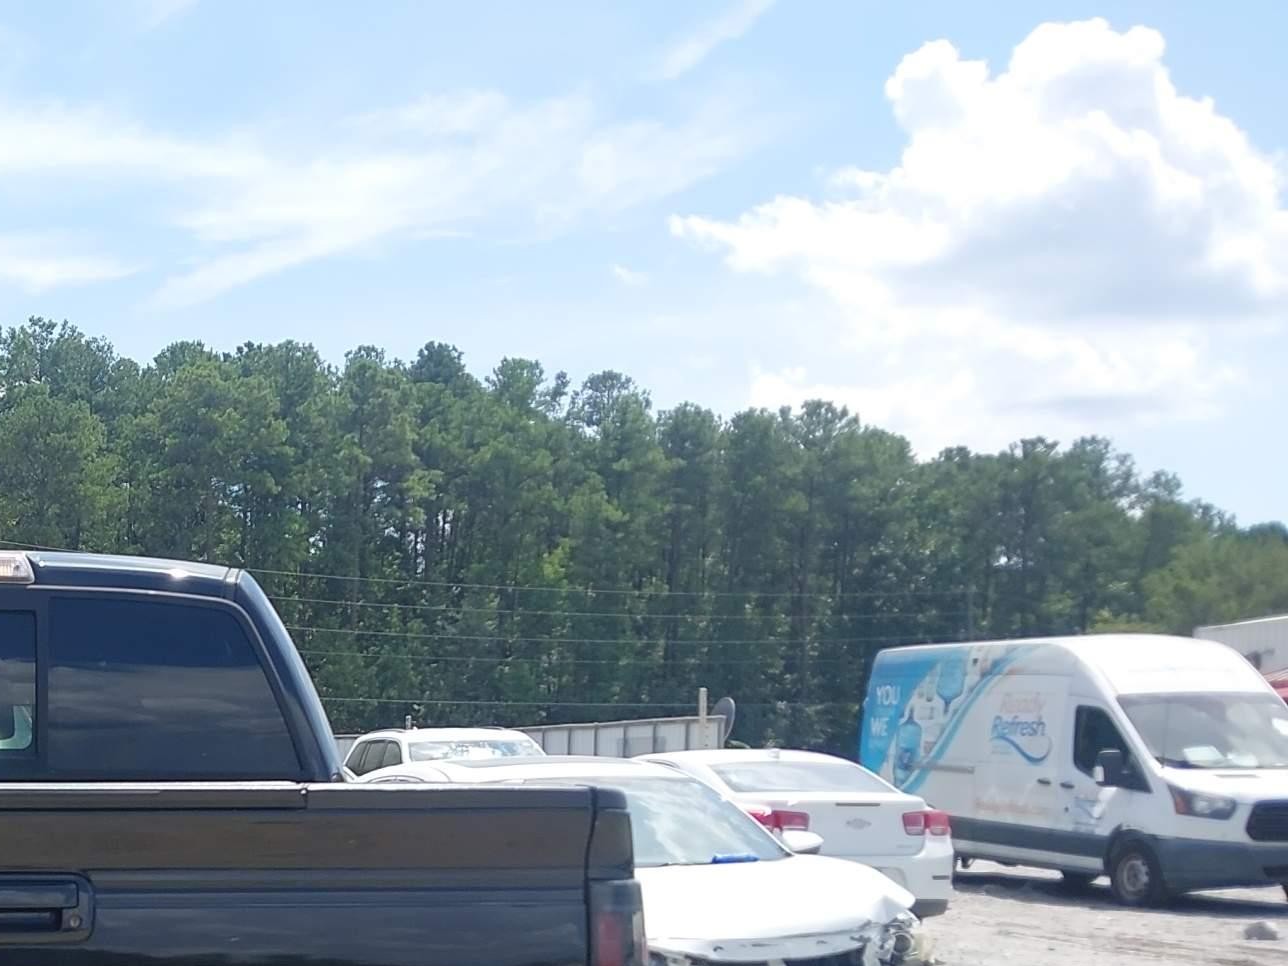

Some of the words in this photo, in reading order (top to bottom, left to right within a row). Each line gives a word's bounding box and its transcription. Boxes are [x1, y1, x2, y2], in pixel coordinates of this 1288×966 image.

[876, 685, 901, 705] YOU
[870, 717, 889, 737] WE
[991, 715, 1047, 737] Refresh
